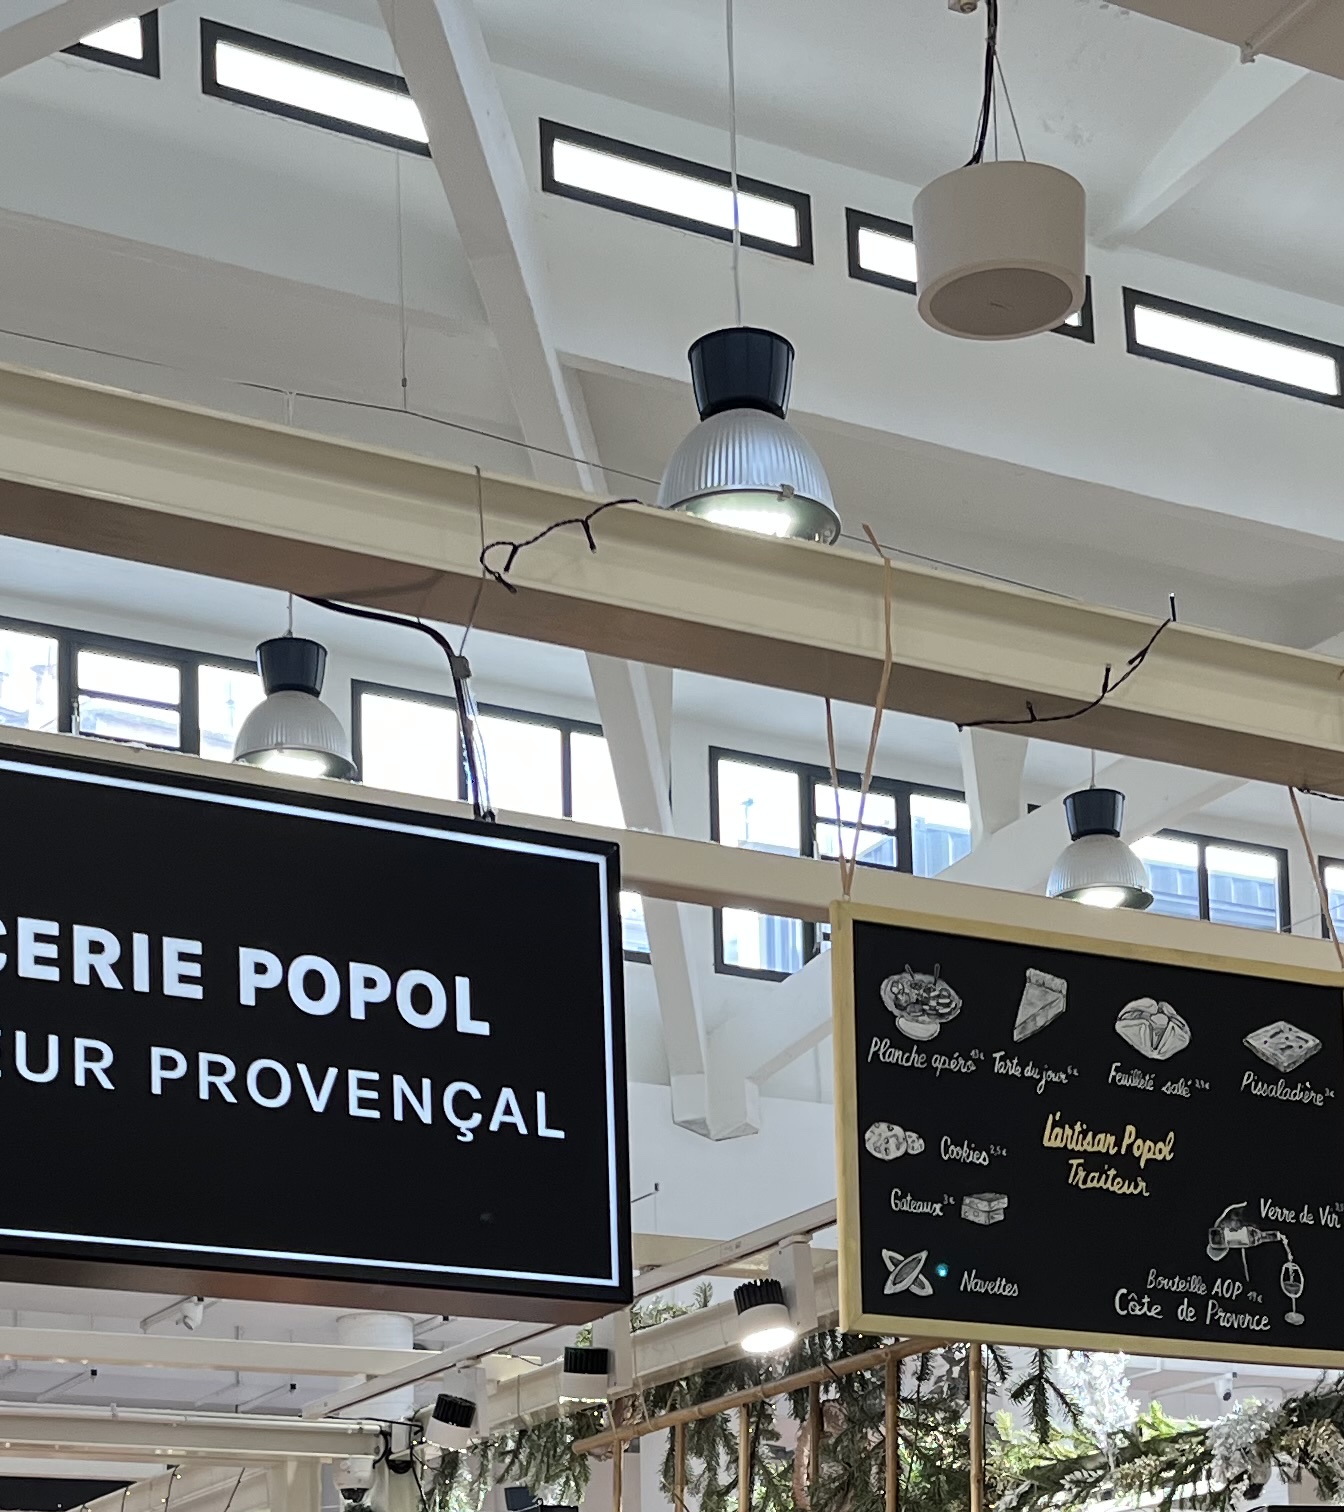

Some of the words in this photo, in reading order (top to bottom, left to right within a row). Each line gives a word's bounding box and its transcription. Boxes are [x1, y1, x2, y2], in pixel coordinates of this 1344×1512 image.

[237, 944, 491, 1038] POPOL
[868, 1037, 927, 1068] Planche
[931, 1051, 977, 1077] apéro
[992, 1051, 1022, 1077] Tarte
[1024, 1060, 1041, 1079] du
[1036, 1064, 1068, 1094] jour
[149, 1045, 566, 1143] PROVENÇAL
[1161, 1078, 1192, 1098] salé
[1240, 1071, 1324, 1106] Pissaladière
[940, 1135, 989, 1166] Cookies
[1120, 1124, 1174, 1168] Popol
[1068, 1159, 1150, 1196] Traiteur
[890, 1188, 943, 1217] Gateaux
[1260, 1198, 1297, 1224] Verre
[1299, 1205, 1315, 1224] de
[1320, 1205, 1341, 1229] Vin
[959, 1269, 1019, 1297] Navettes
[1146, 1268, 1207, 1296] Bouteille
[1211, 1278, 1243, 1300] AOP
[1114, 1288, 1164, 1320] Côte
[1177, 1298, 1197, 1322] de
[1206, 1300, 1271, 1331] Provence
